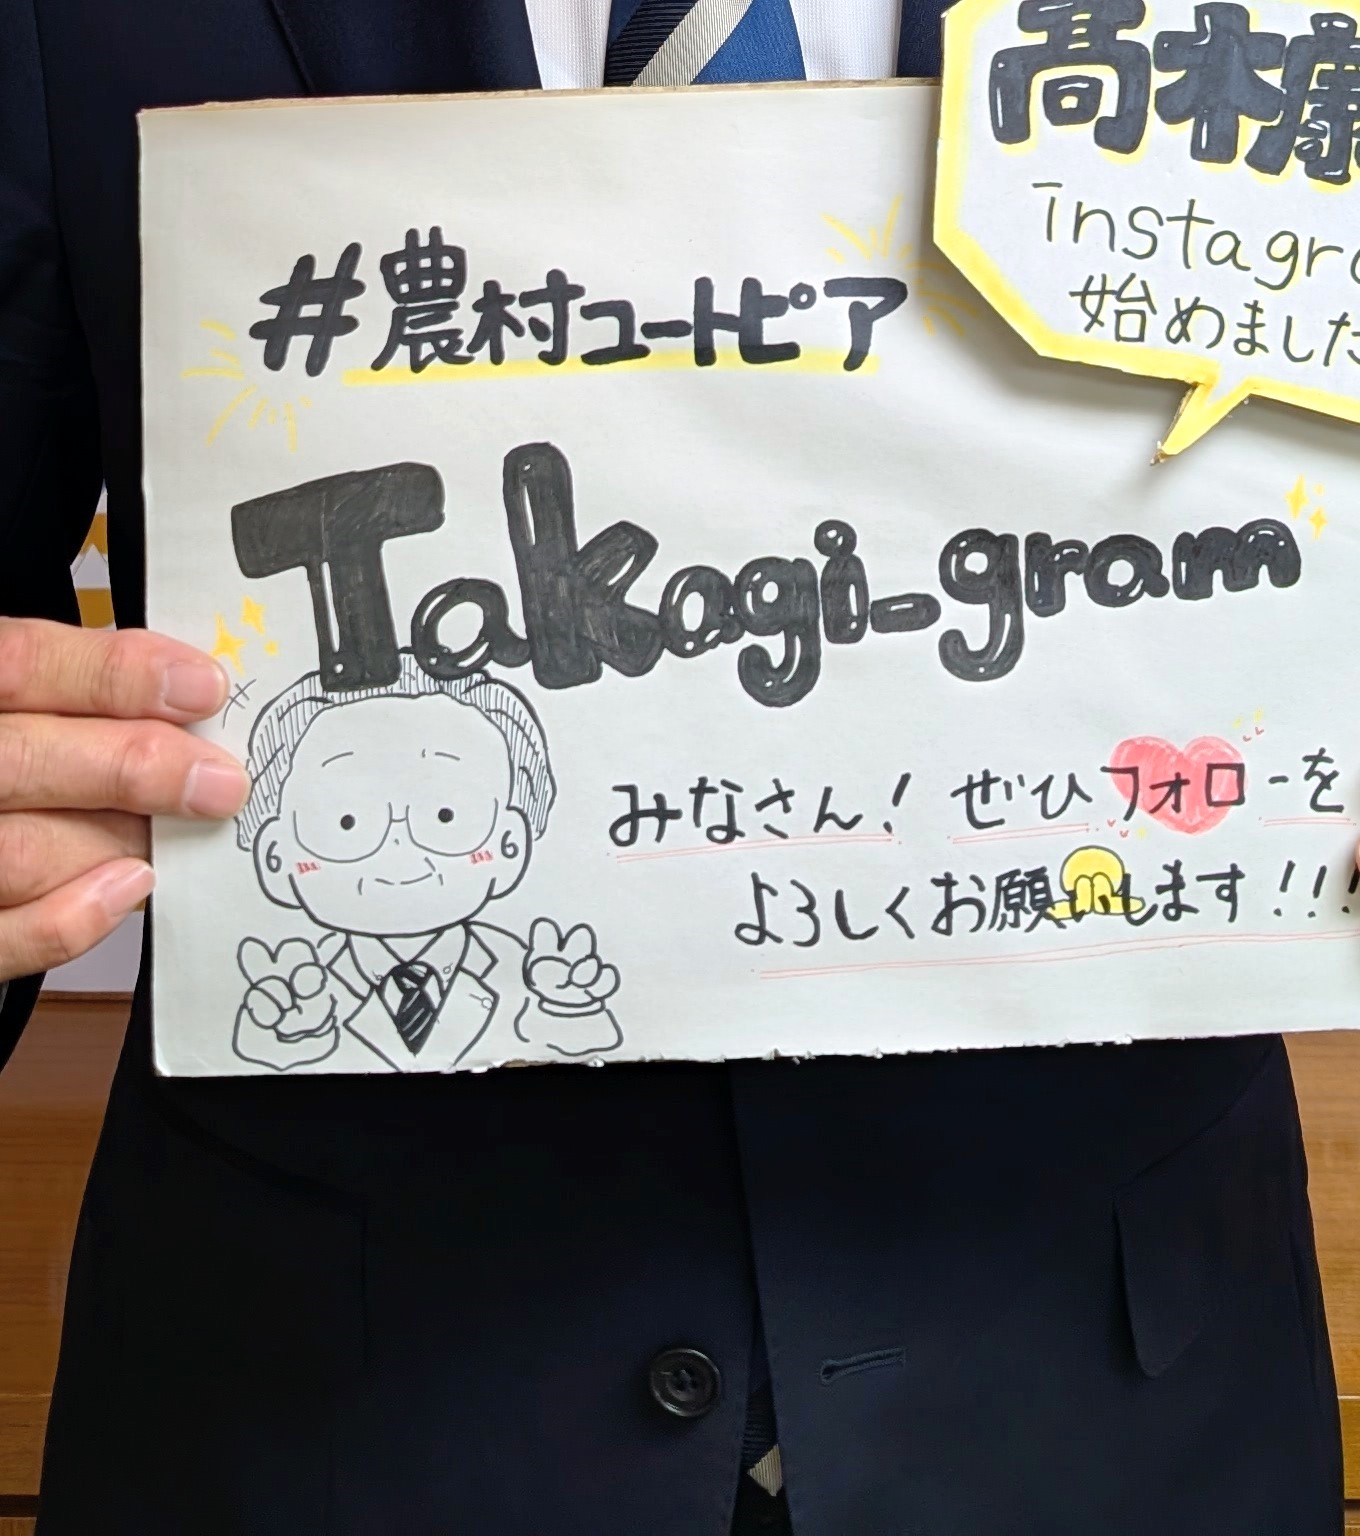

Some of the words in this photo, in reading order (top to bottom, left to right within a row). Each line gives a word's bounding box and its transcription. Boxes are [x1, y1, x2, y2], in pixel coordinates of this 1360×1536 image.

[249, 226, 908, 377] #農村ユートピア
[609, 771, 913, 849] みなさん！
[951, 746, 1349, 832] ぜひフォローを
